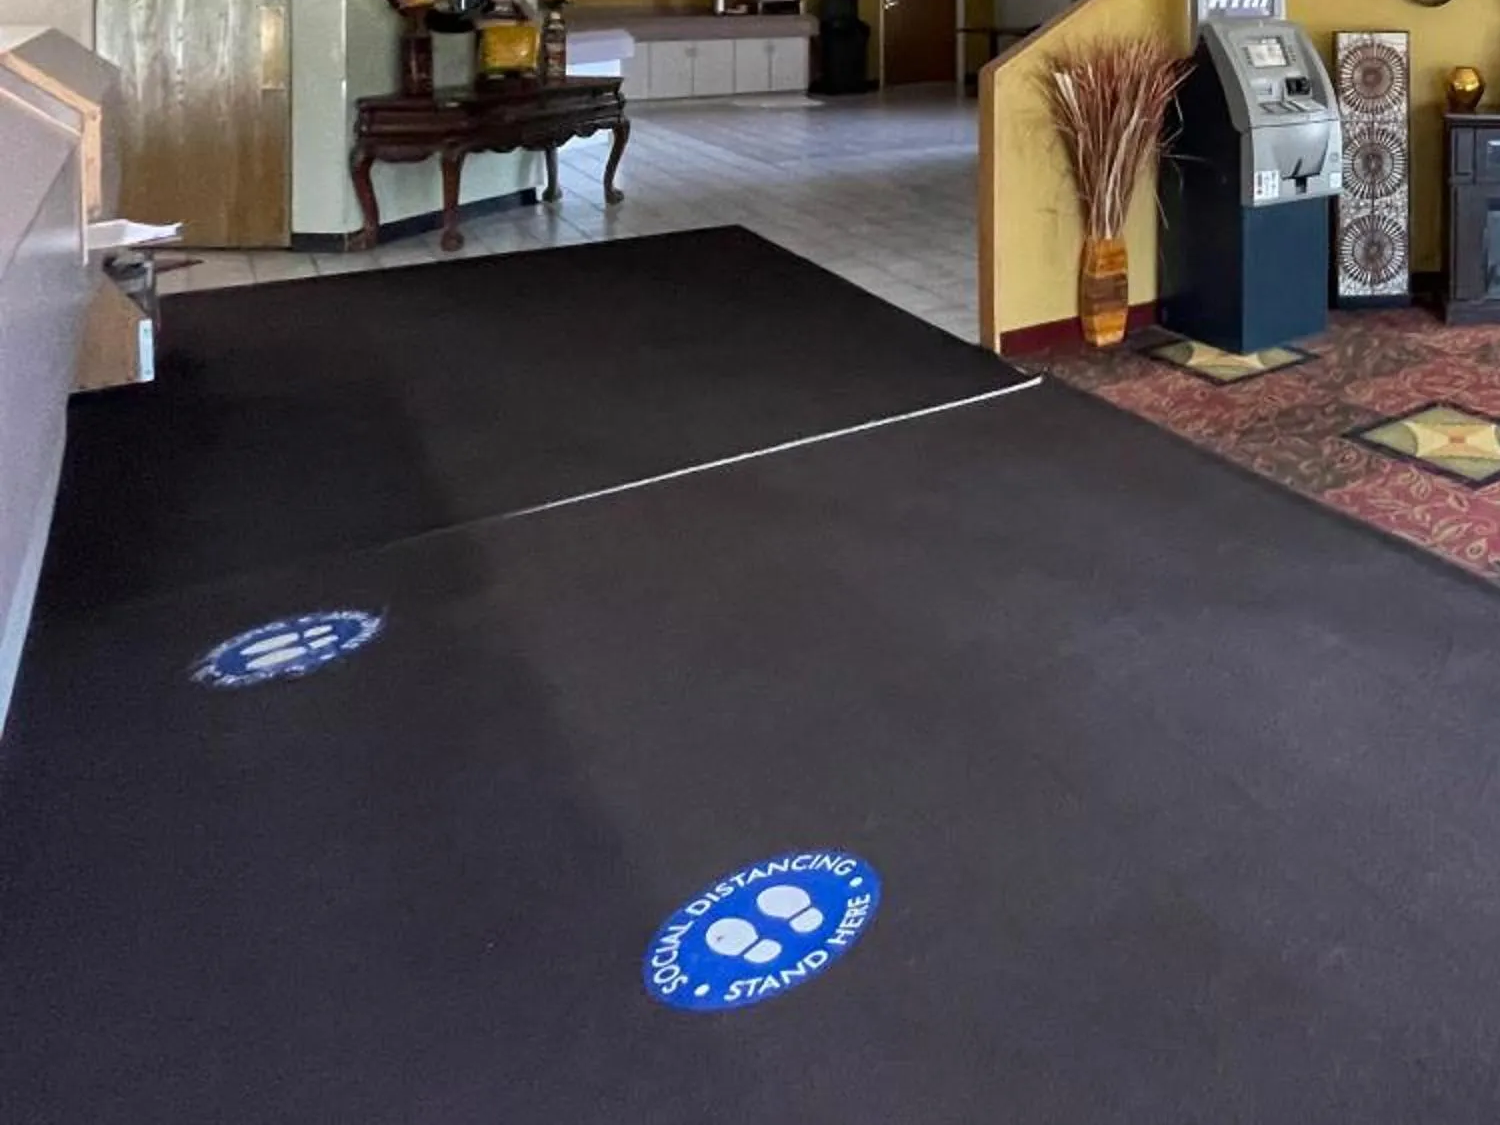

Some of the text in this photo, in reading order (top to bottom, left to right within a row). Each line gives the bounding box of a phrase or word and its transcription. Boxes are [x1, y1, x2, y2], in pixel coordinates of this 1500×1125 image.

[652, 854, 857, 995] SOCIAL DISTANCING
[724, 893, 871, 1001] STAND HERE
